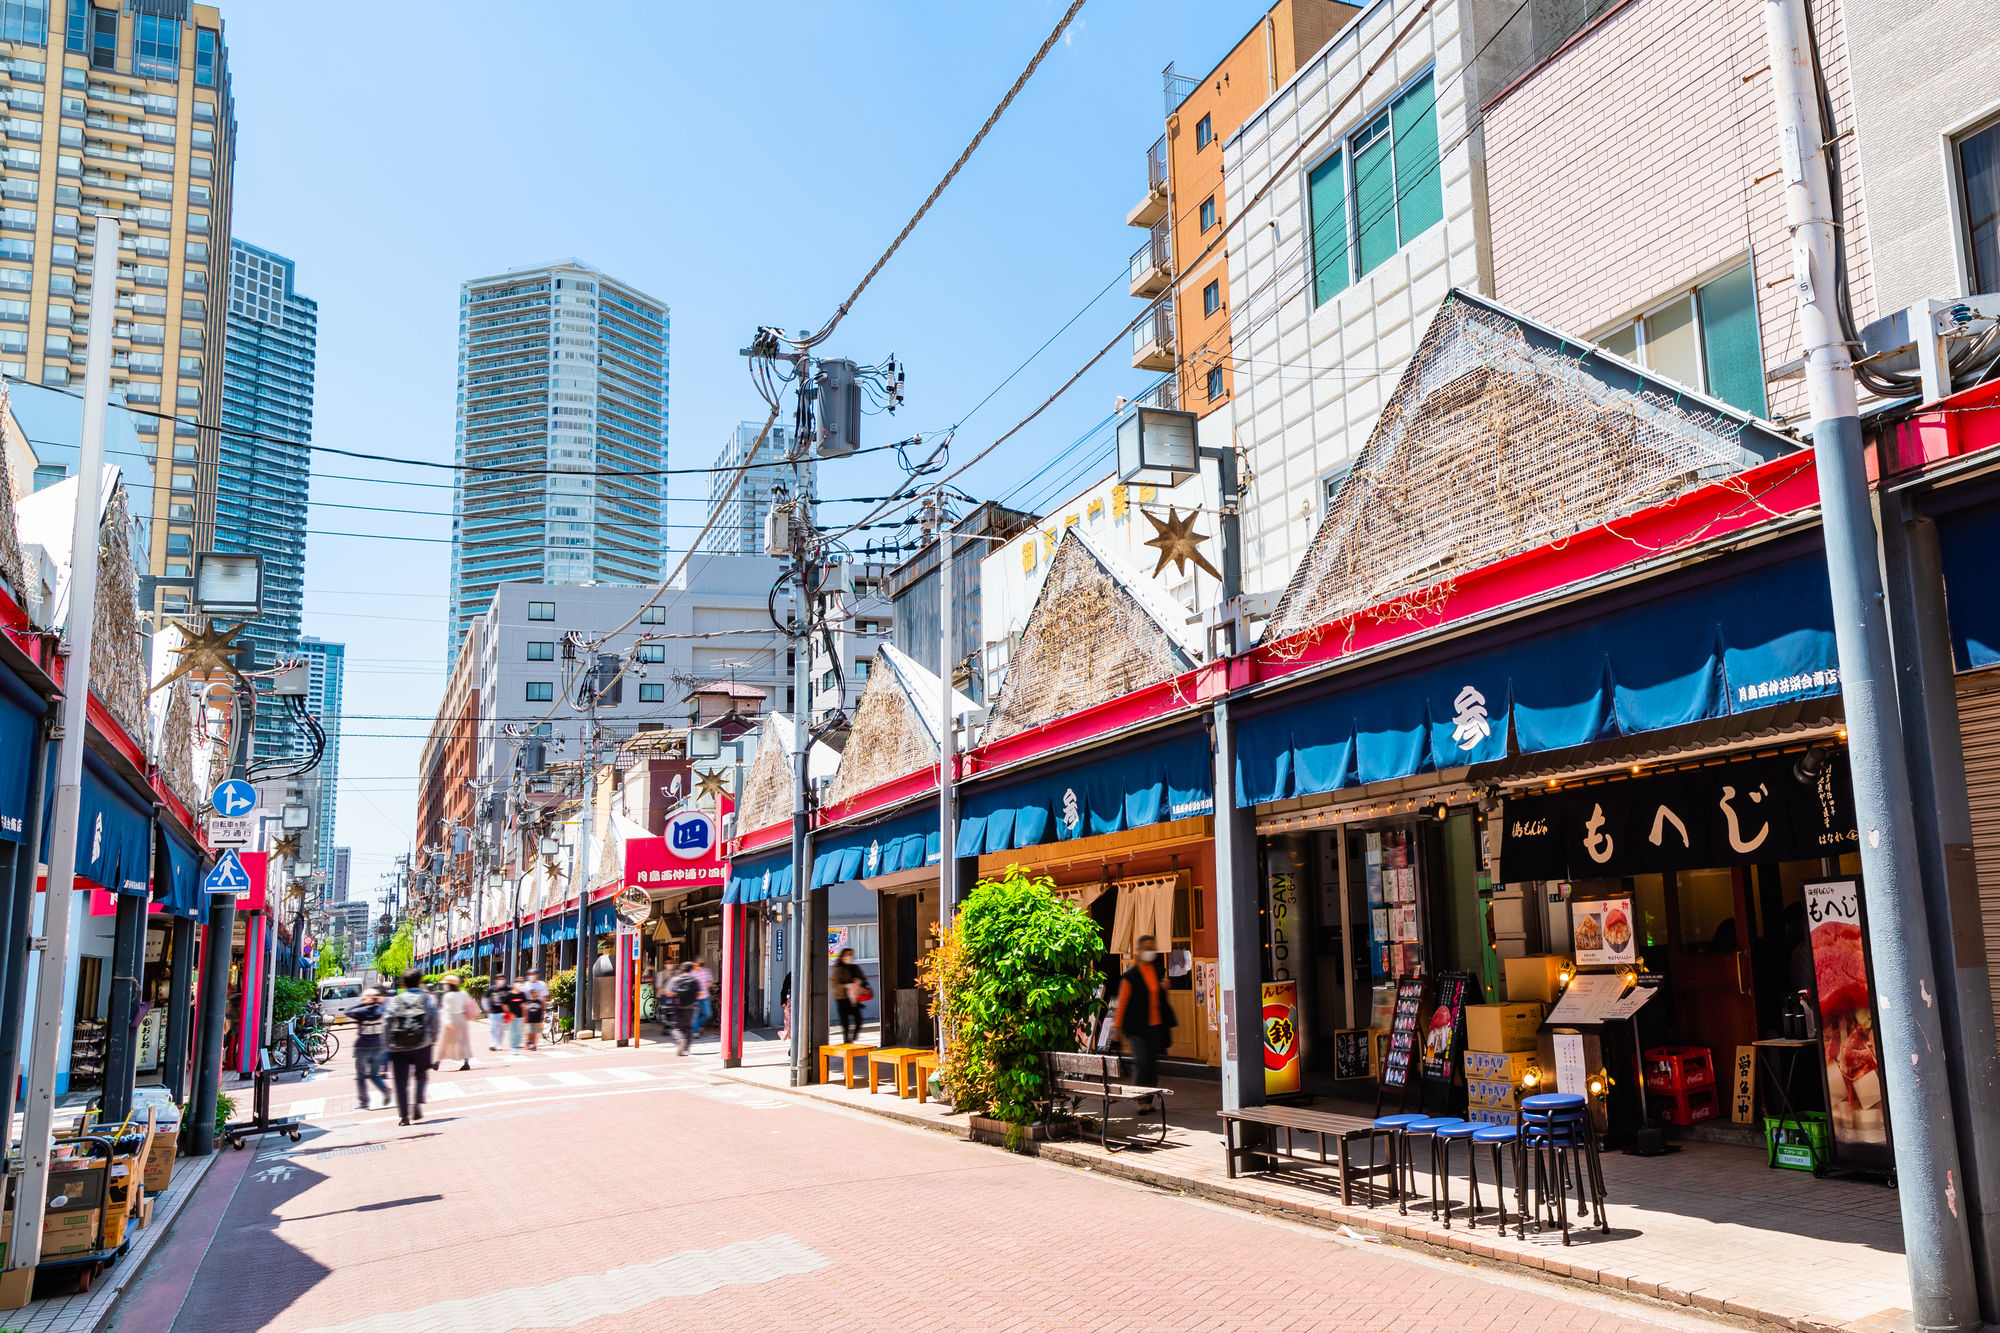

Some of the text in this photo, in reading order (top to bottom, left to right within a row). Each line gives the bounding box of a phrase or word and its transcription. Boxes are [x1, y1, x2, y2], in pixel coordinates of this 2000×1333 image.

[211, 829, 252, 837] 一方通行
[212, 820, 252, 829] 自転車を除く
[673, 818, 709, 850] 四
[1583, 782, 1770, 864] もへじ
[1809, 894, 1857, 922] もへじ
[141, 1026, 151, 1049] おしお
[1267, 1018, 1295, 1046] 錦
[1477, 1055, 1504, 1070] キャベツ
[1481, 1084, 1507, 1098] キャベツ
